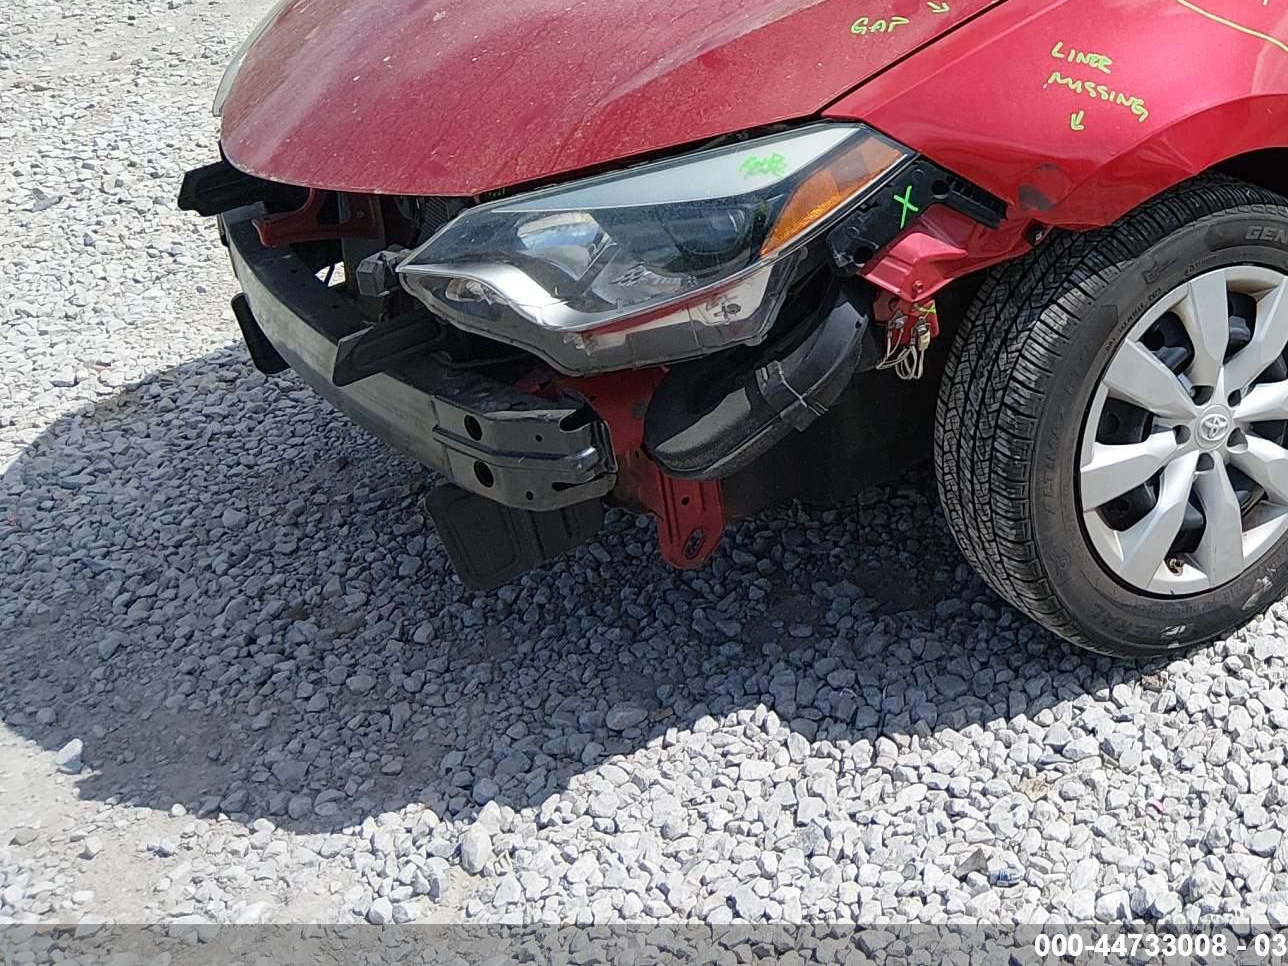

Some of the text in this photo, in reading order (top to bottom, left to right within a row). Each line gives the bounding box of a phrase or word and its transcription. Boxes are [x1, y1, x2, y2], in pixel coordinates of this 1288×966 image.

[850, 16, 910, 35] GAP
[1050, 41, 1113, 74] LINER
[1047, 71, 1150, 123] MISSING
